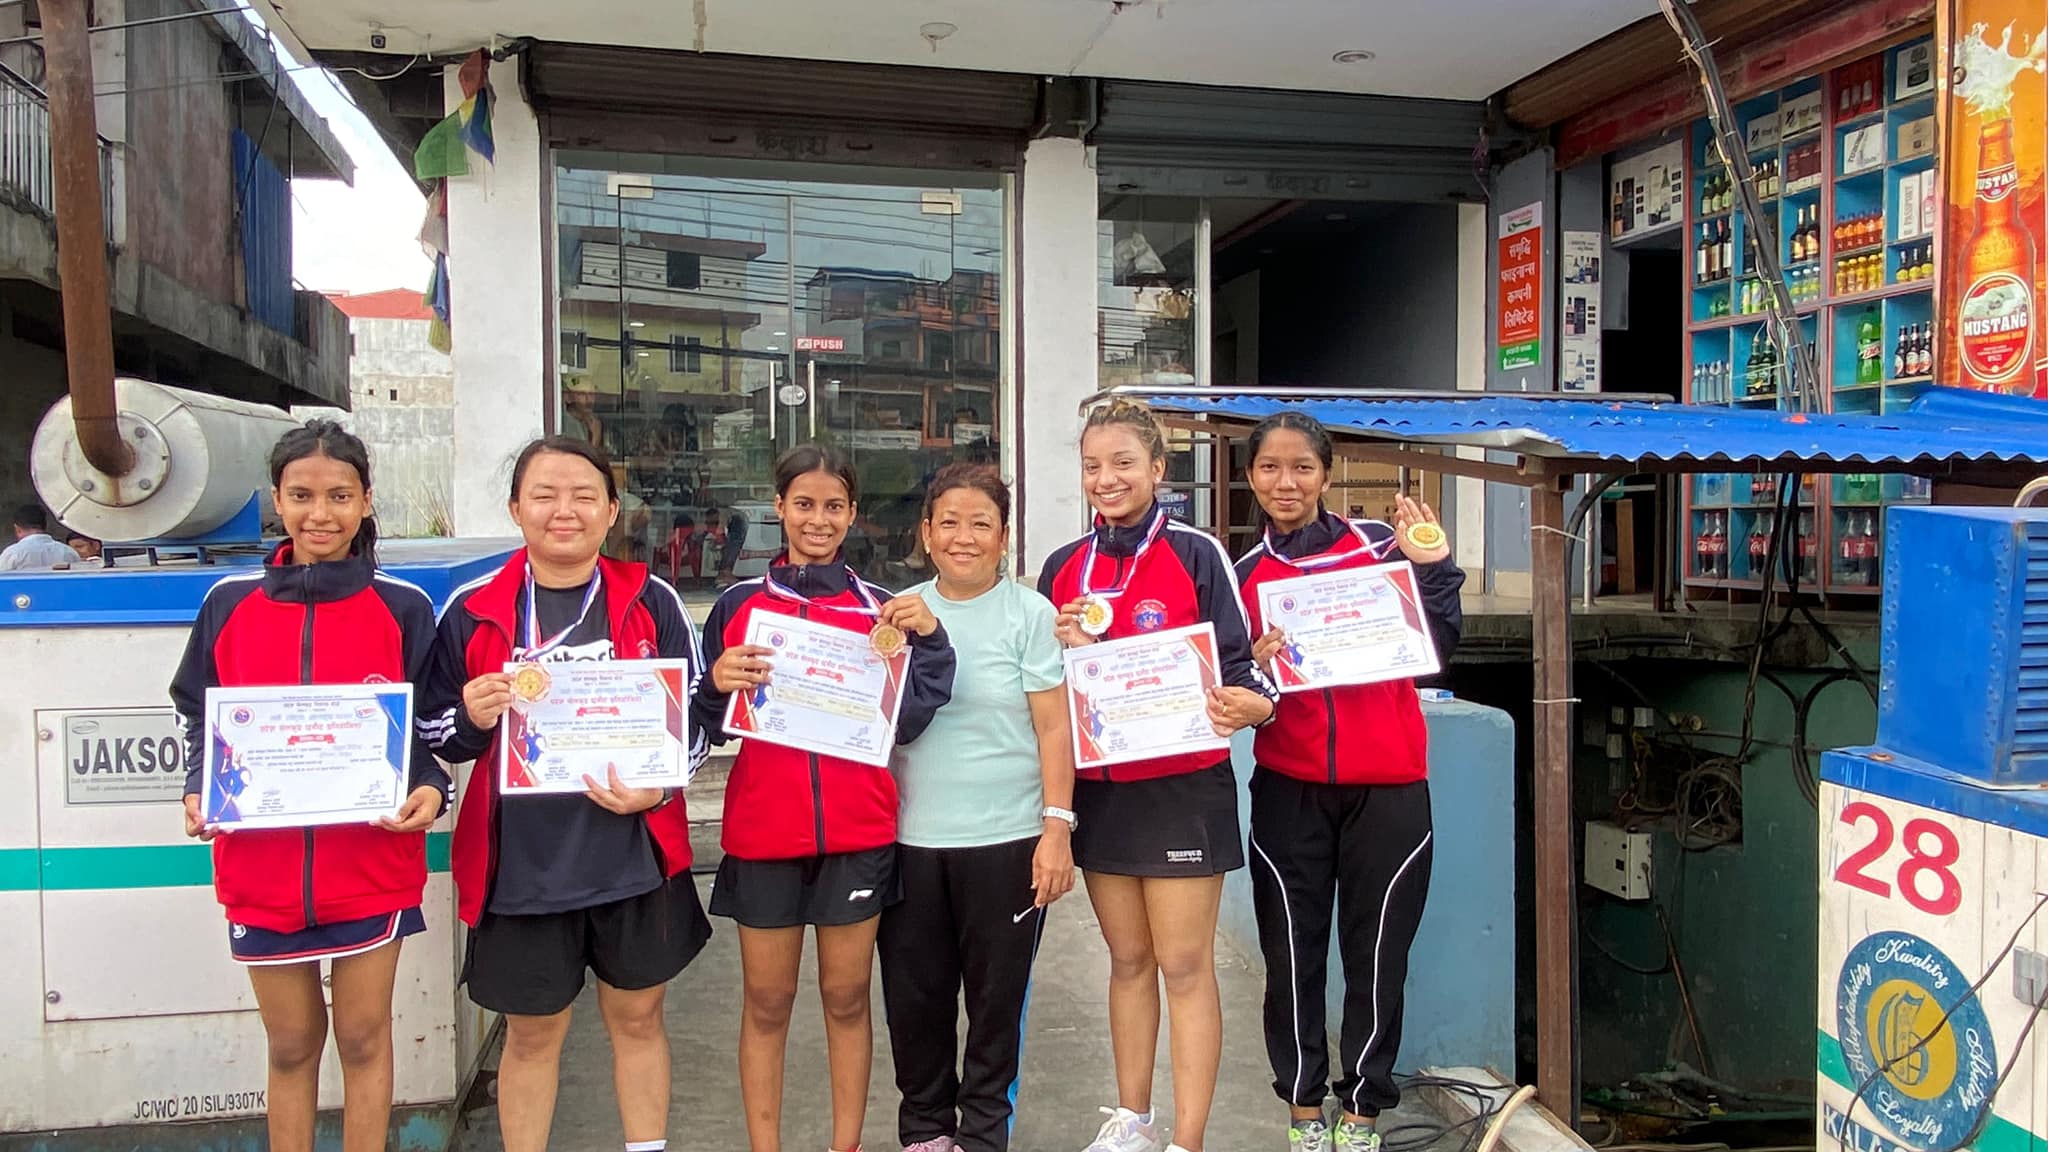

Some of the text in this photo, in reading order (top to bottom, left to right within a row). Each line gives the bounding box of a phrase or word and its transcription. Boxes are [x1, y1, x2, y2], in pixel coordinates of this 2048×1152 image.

[1508, 236, 1532, 261] समृद्धि
[1507, 283, 1532, 304] कम्पनी
[1504, 307, 1535, 329] लिमिटेड
[1963, 311, 2027, 336] MUSTANG
[813, 339, 844, 350] PUSH
[1834, 801, 1963, 916] 28
[1875, 939, 1949, 990] Kwality
[1958, 1027, 1994, 1112] Ability
[183, 1096, 198, 1116] 20
[1876, 1088, 1943, 1144] Loyalty
[1824, 1104, 1908, 1152] KALA
